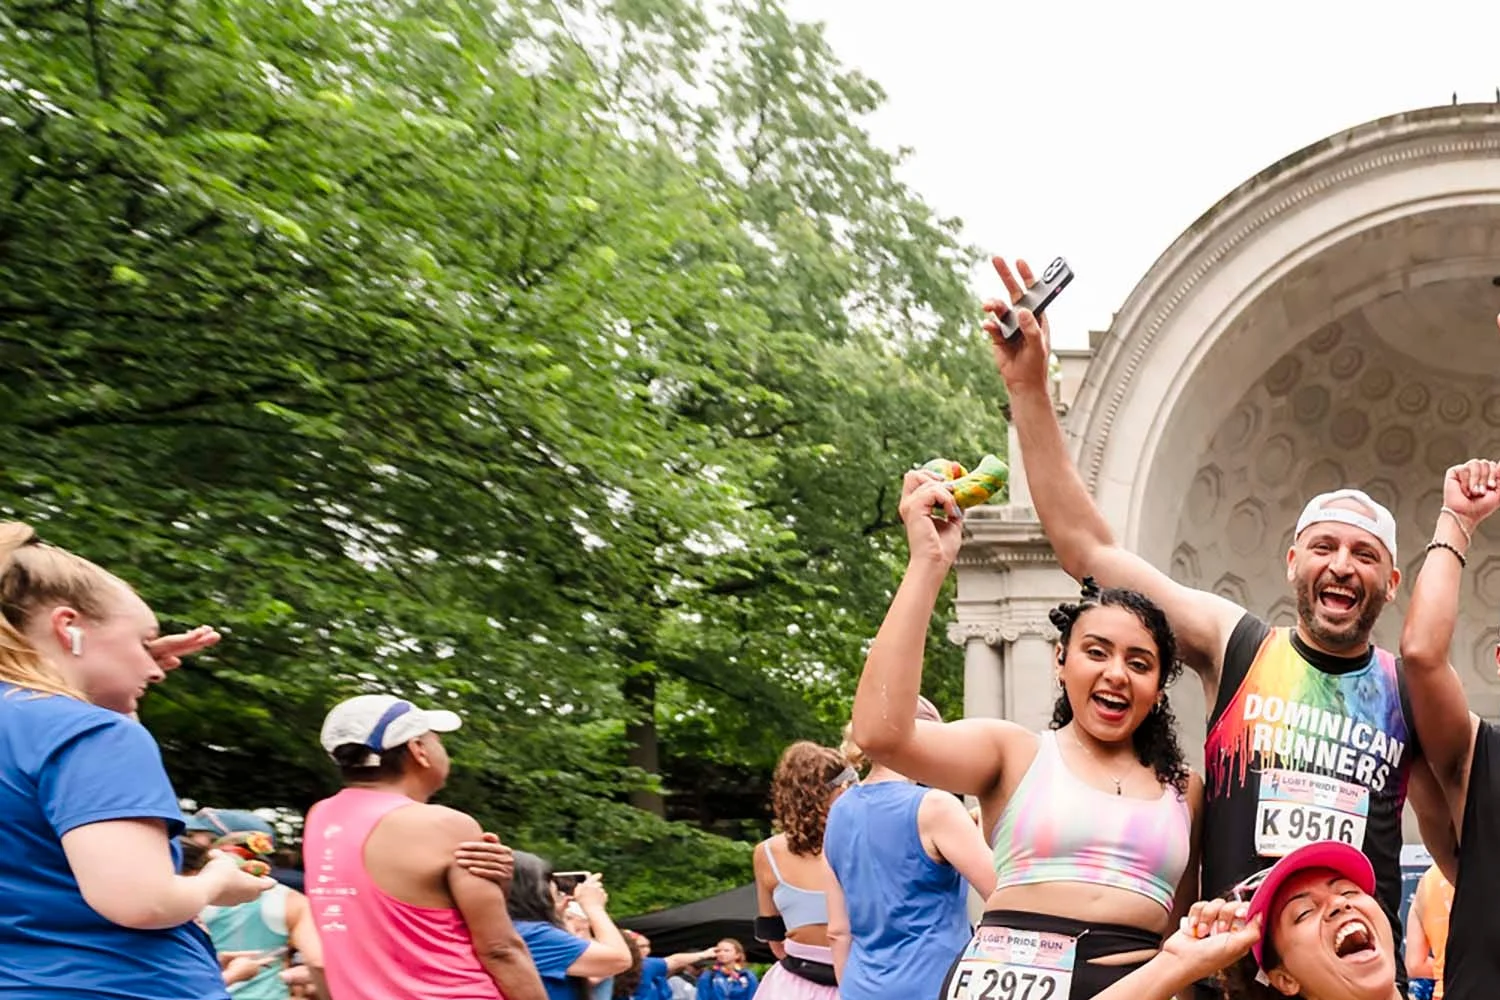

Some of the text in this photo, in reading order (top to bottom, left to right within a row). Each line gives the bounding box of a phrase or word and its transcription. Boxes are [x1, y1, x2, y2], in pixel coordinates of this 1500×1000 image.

[1243, 693, 1405, 769] DOMINICAN
[1253, 723, 1390, 792] RUNNERS
[1282, 775, 1308, 786] LGBT
[1309, 778, 1338, 793] PRIDE
[1339, 785, 1359, 798] RUN
[1261, 808, 1354, 843] K 9516
[983, 934, 1063, 950] LGBT PRIDE RUN
[953, 970, 972, 999] F
